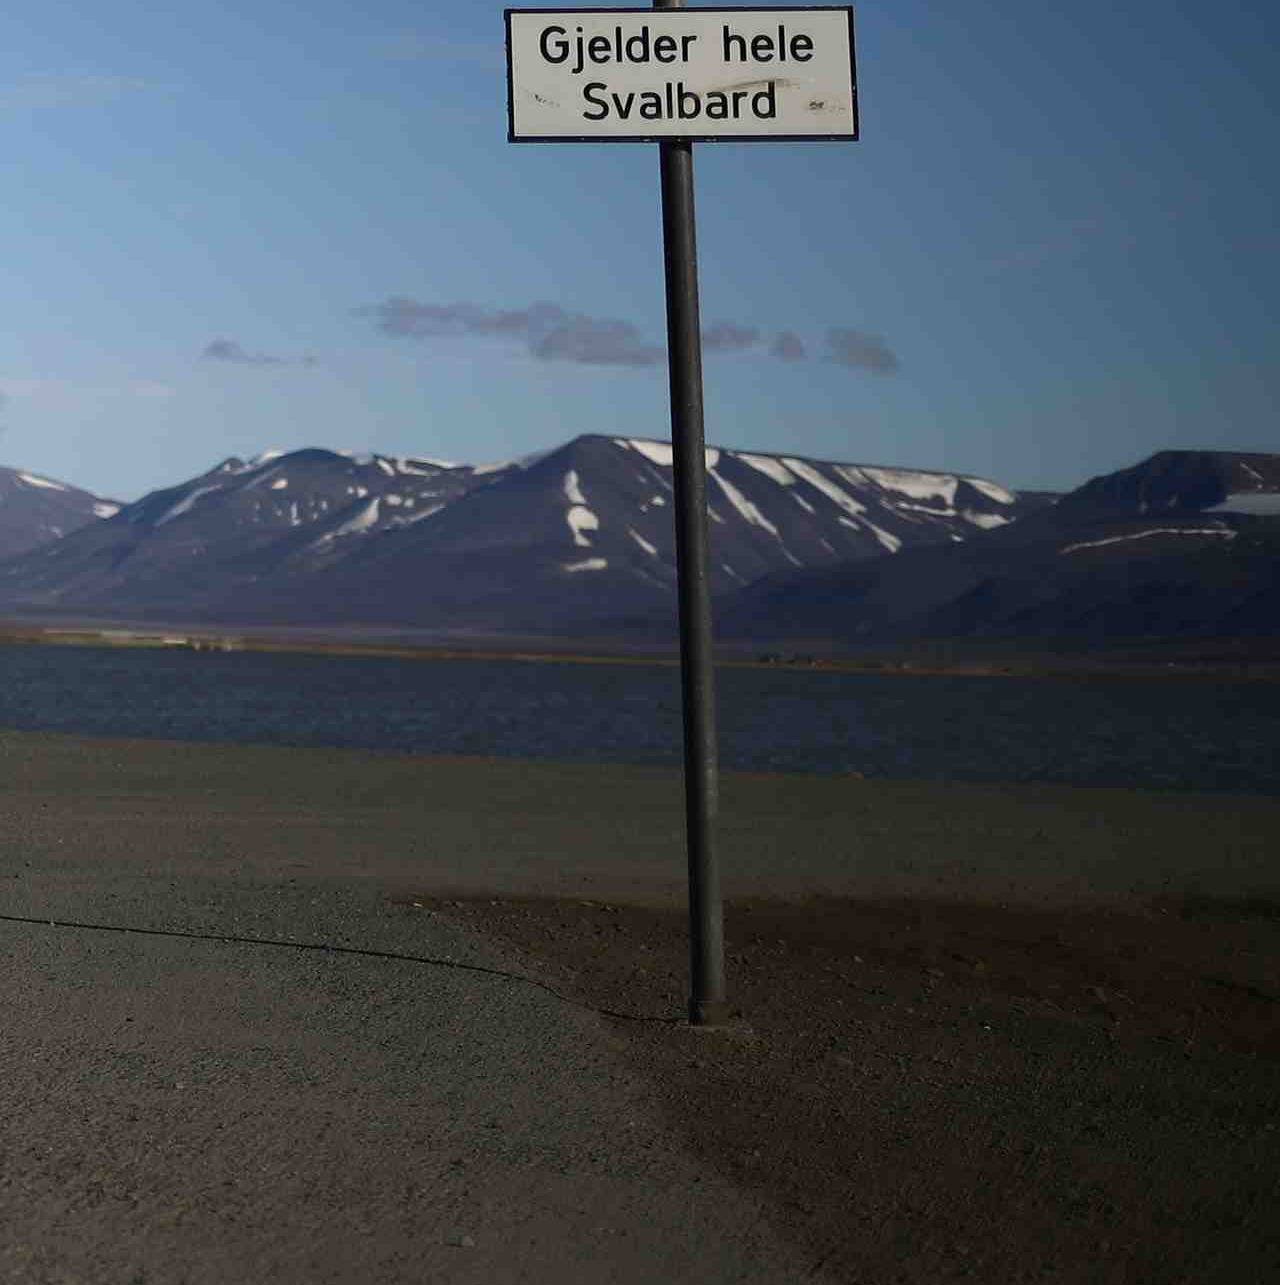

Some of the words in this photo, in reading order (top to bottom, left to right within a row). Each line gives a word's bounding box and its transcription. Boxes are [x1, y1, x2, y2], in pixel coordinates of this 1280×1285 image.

[539, 25, 698, 75] Gjelder
[722, 24, 814, 63] hele
[582, 80, 777, 121] Svalbard
